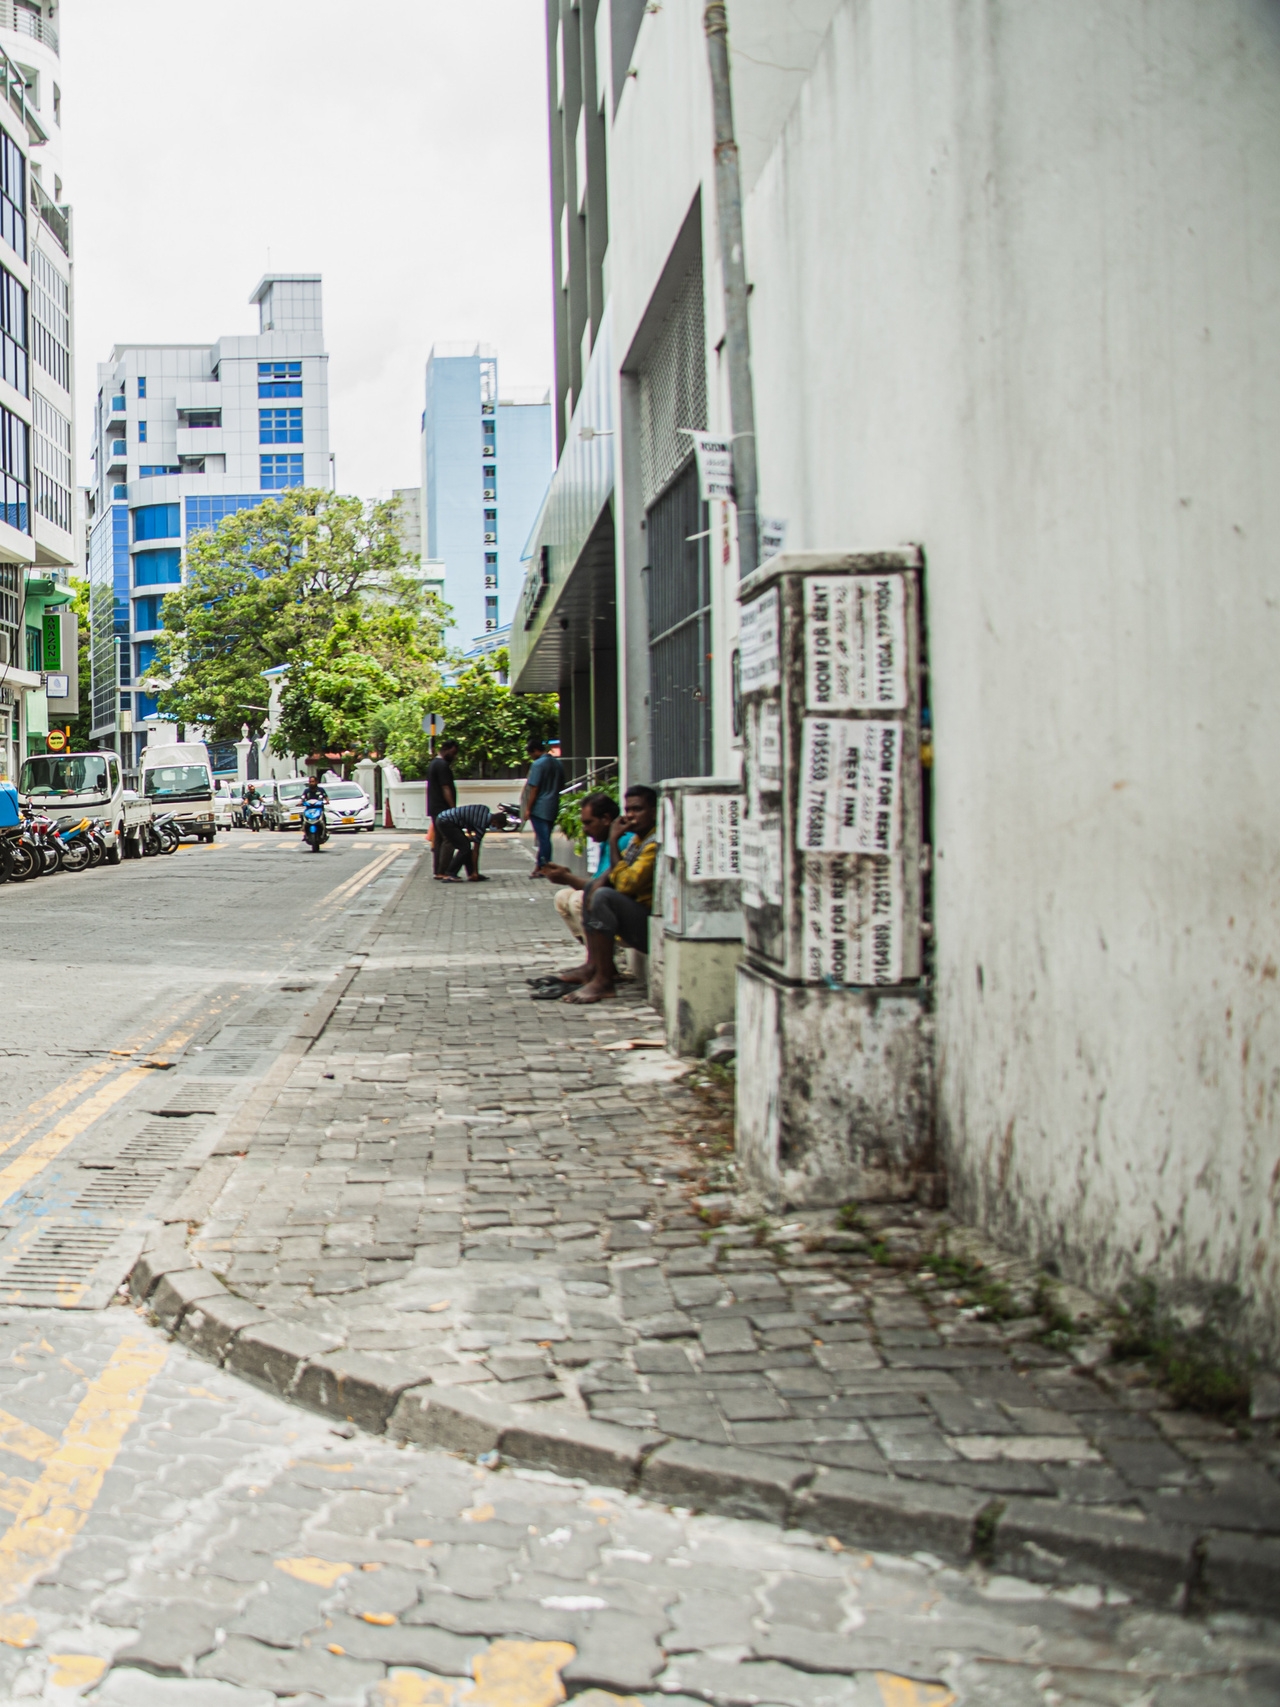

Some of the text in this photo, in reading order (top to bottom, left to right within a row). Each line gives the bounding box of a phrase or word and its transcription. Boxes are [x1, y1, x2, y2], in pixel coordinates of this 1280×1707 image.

[47, 617, 56, 657] AMAZON
[812, 585, 830, 703] ROOM FOR RENT
[844, 747, 860, 827] REST INN
[876, 728, 896, 850] ROOM FOR RENT
[830, 861, 844, 899] RENT
[830, 904, 846, 934] FOR
[831, 939, 846, 982] ROOM
